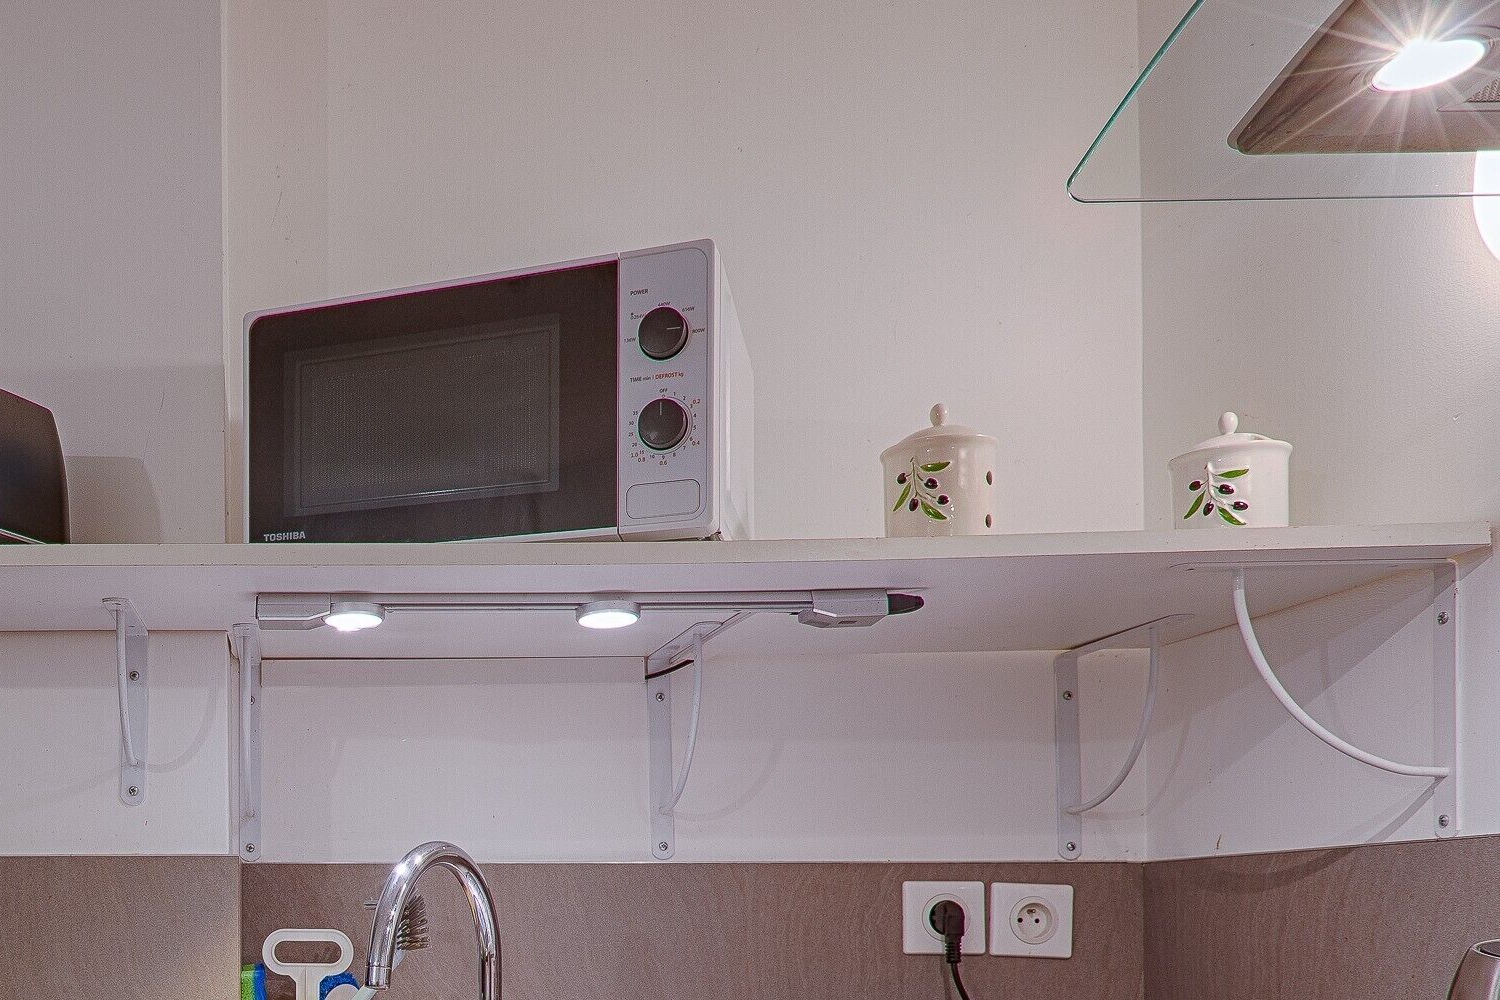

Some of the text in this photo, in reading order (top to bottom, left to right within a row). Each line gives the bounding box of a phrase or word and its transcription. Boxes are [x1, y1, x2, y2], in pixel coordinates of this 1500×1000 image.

[630, 288, 649, 296] POWER
[655, 371, 678, 380] DEFROST
[263, 531, 306, 542] TOSHIBA
